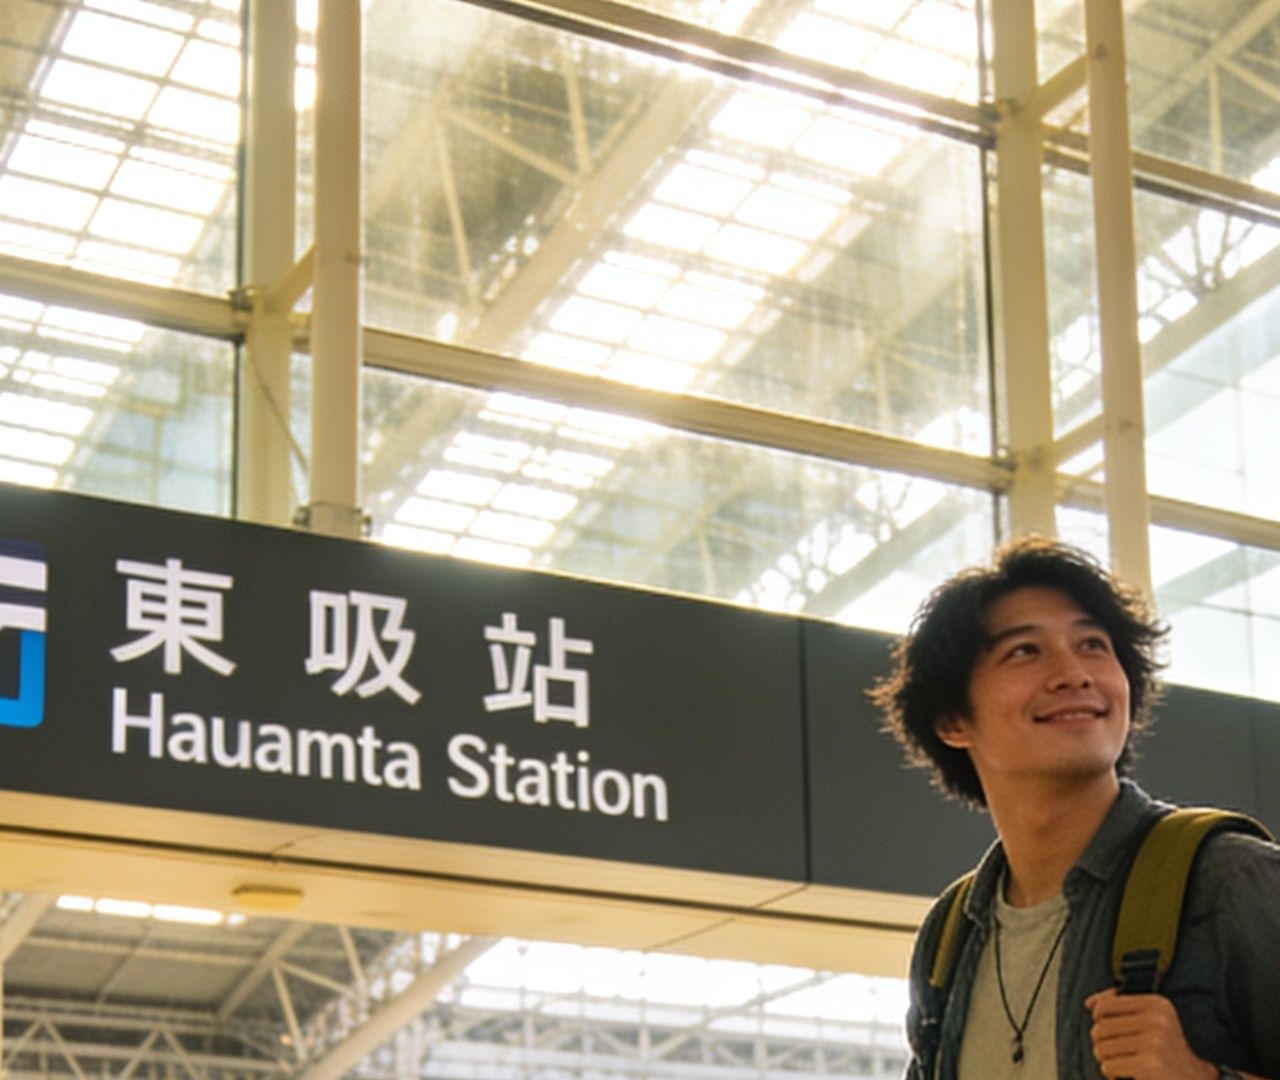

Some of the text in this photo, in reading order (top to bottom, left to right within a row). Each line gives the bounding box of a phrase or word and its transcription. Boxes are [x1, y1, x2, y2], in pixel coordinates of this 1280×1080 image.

[109, 557, 595, 729] 東吸站
[111, 686, 669, 823] Hauamta Station
